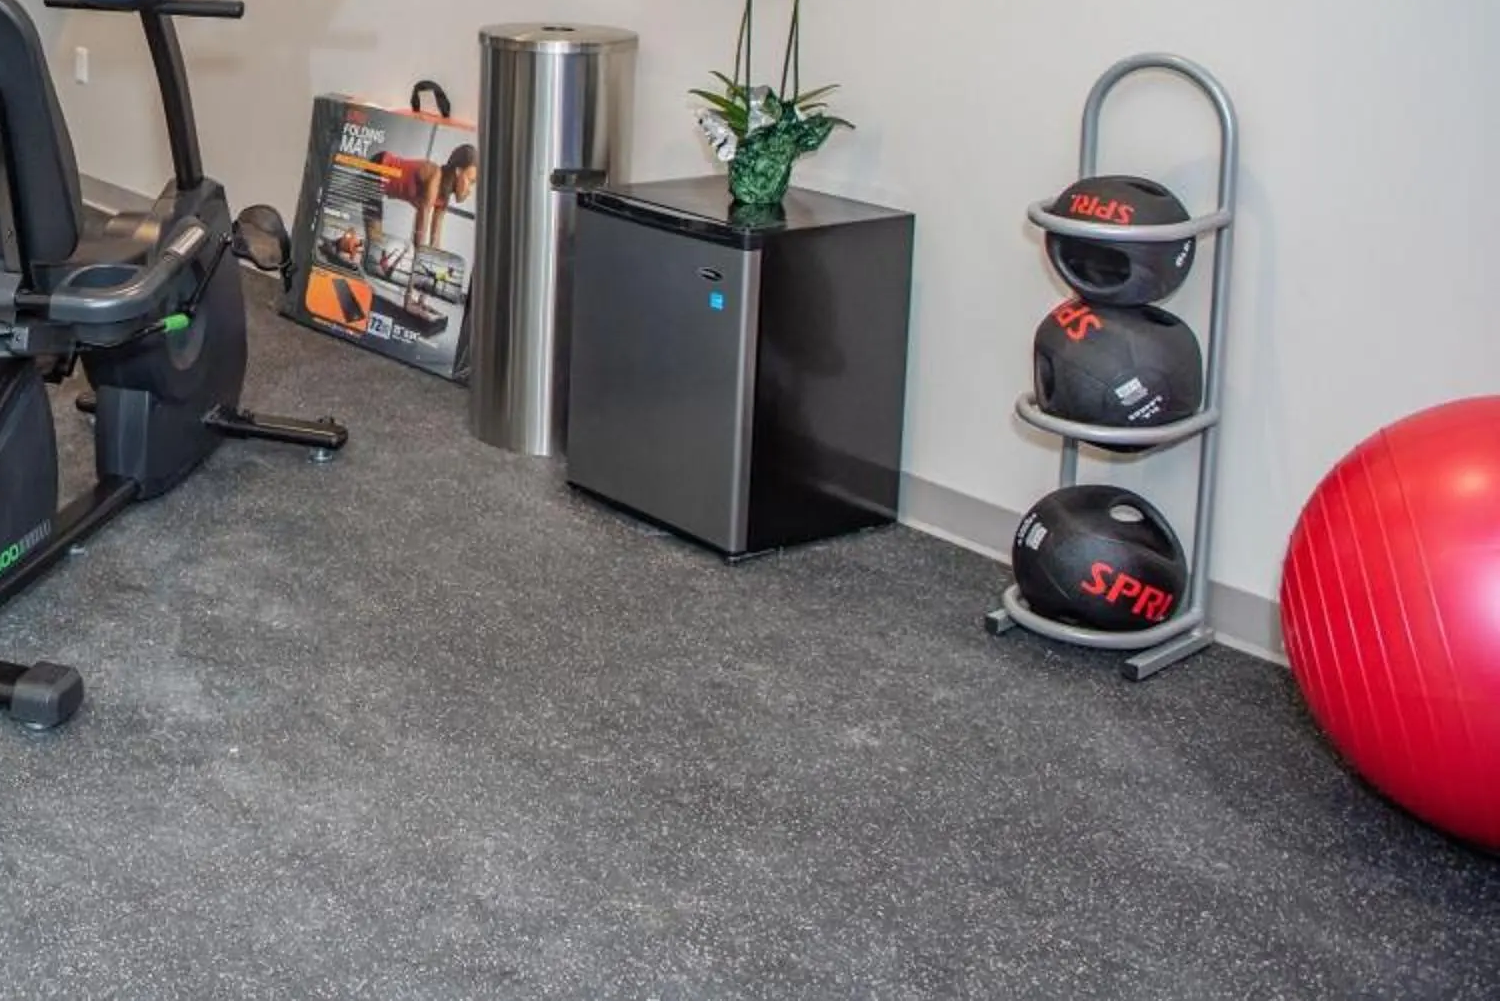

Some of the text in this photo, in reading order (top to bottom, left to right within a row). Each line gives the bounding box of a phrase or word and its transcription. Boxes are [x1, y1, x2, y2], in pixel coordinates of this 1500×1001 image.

[339, 135, 372, 158] MAT
[342, 122, 386, 144] FOLDING
[1070, 194, 1135, 225] SPRI
[1080, 561, 1174, 621] SPRI
